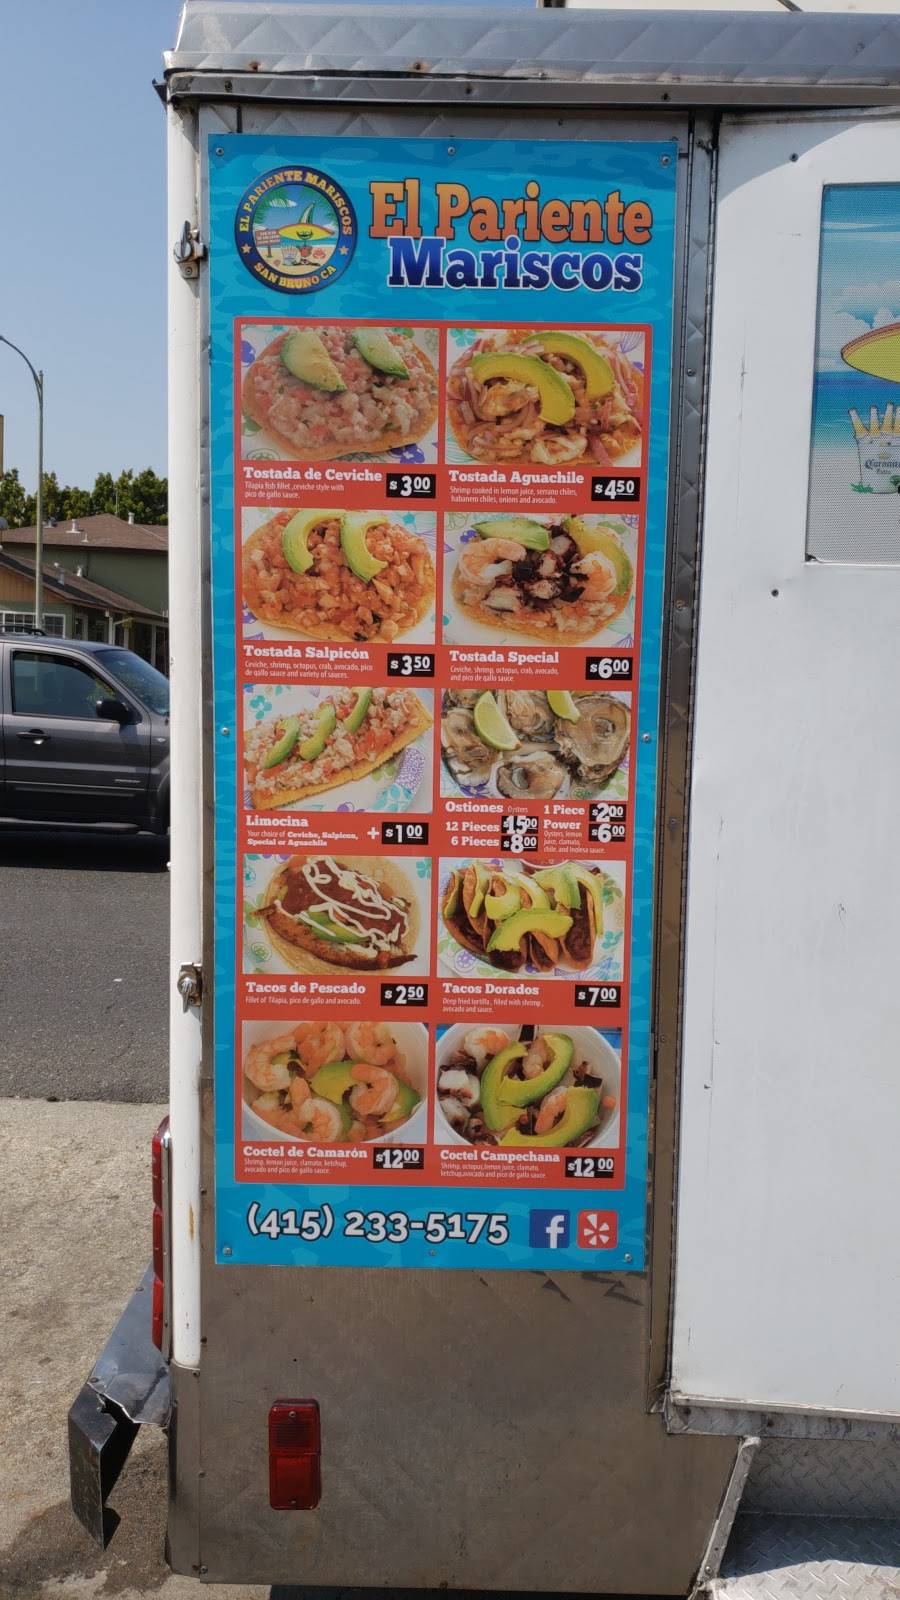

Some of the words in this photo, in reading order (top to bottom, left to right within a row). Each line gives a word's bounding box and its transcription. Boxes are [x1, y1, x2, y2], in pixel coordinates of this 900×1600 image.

[243, 170, 303, 212] PARIENTE
[305, 172, 352, 235] MARISCOS
[369, 178, 422, 239] El
[435, 180, 653, 244] Pariente
[240, 215, 250, 232] EL
[387, 235, 643, 293] Mariscos
[254, 263, 278, 283] SAN
[279, 276, 319, 288] BRUNO
[320, 266, 336, 279] CA
[243, 467, 301, 479] Tostada
[305, 469, 321, 480] de
[325, 469, 382, 481] Ceviche
[449, 470, 506, 483] Tostada
[510, 471, 584, 485] Aguachile
[243, 645, 301, 657] Tostada
[305, 647, 369, 661] Salpicón
[450, 650, 504, 662] Tostada
[508, 652, 559, 665] Special
[445, 801, 503, 812] Ostiones
[544, 805, 550, 814] 1
[553, 805, 585, 815] Piece
[246, 815, 308, 827] Limocina
[446, 822, 459, 831] 12
[462, 821, 499, 832] Pieces
[544, 819, 581, 829] Power
[288, 839, 327, 847] Aguachile
[451, 836, 458, 846] 6
[462, 836, 499, 847] Pieces
[246, 982, 286, 993] Tacos
[290, 982, 306, 993] de
[310, 983, 366, 994] Pescado
[443, 983, 482, 993] Tacos
[485, 983, 539, 995] Dorados
[243, 1146, 284, 1156] Coctel
[287, 1147, 304, 1157] de
[307, 1147, 367, 1158] Camarón
[440, 1150, 478, 1161] Coctel
[481, 1151, 560, 1163] Campechana
[246, 1201, 334, 1242] (415)
[343, 1209, 509, 1244] 233-5175
